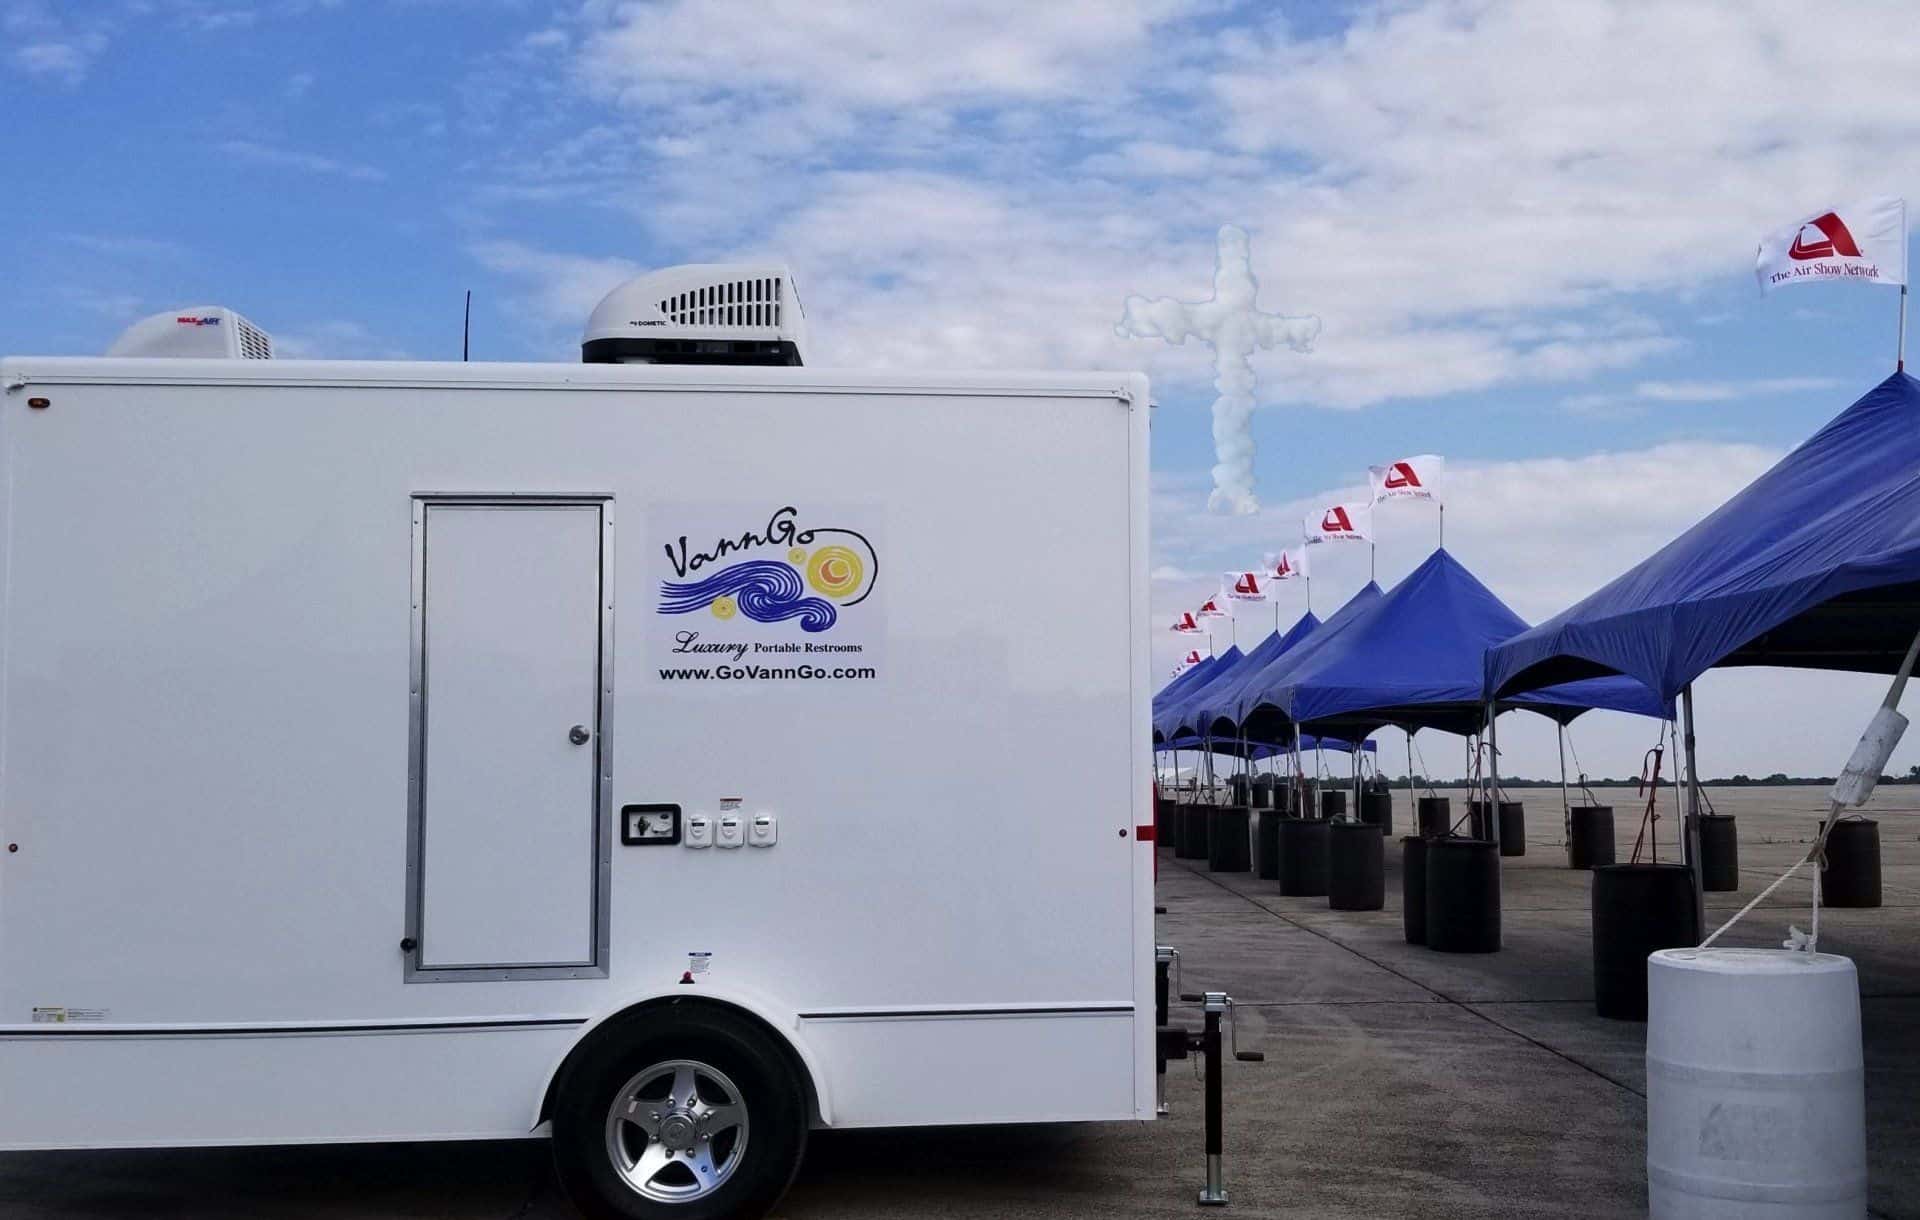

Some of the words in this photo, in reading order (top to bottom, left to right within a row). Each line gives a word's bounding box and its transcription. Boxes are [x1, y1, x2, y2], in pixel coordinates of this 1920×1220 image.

[1770, 271, 1791, 283] The
[1793, 265, 1812, 276] Air
[1814, 262, 1841, 275] Show
[1844, 263, 1880, 279] Network
[665, 507, 822, 578] VannGo
[672, 630, 750, 662] Luxury
[754, 642, 801, 653] Portable
[804, 642, 863, 653] Restrooms
[659, 665, 876, 680] www.GoVannGo.com
